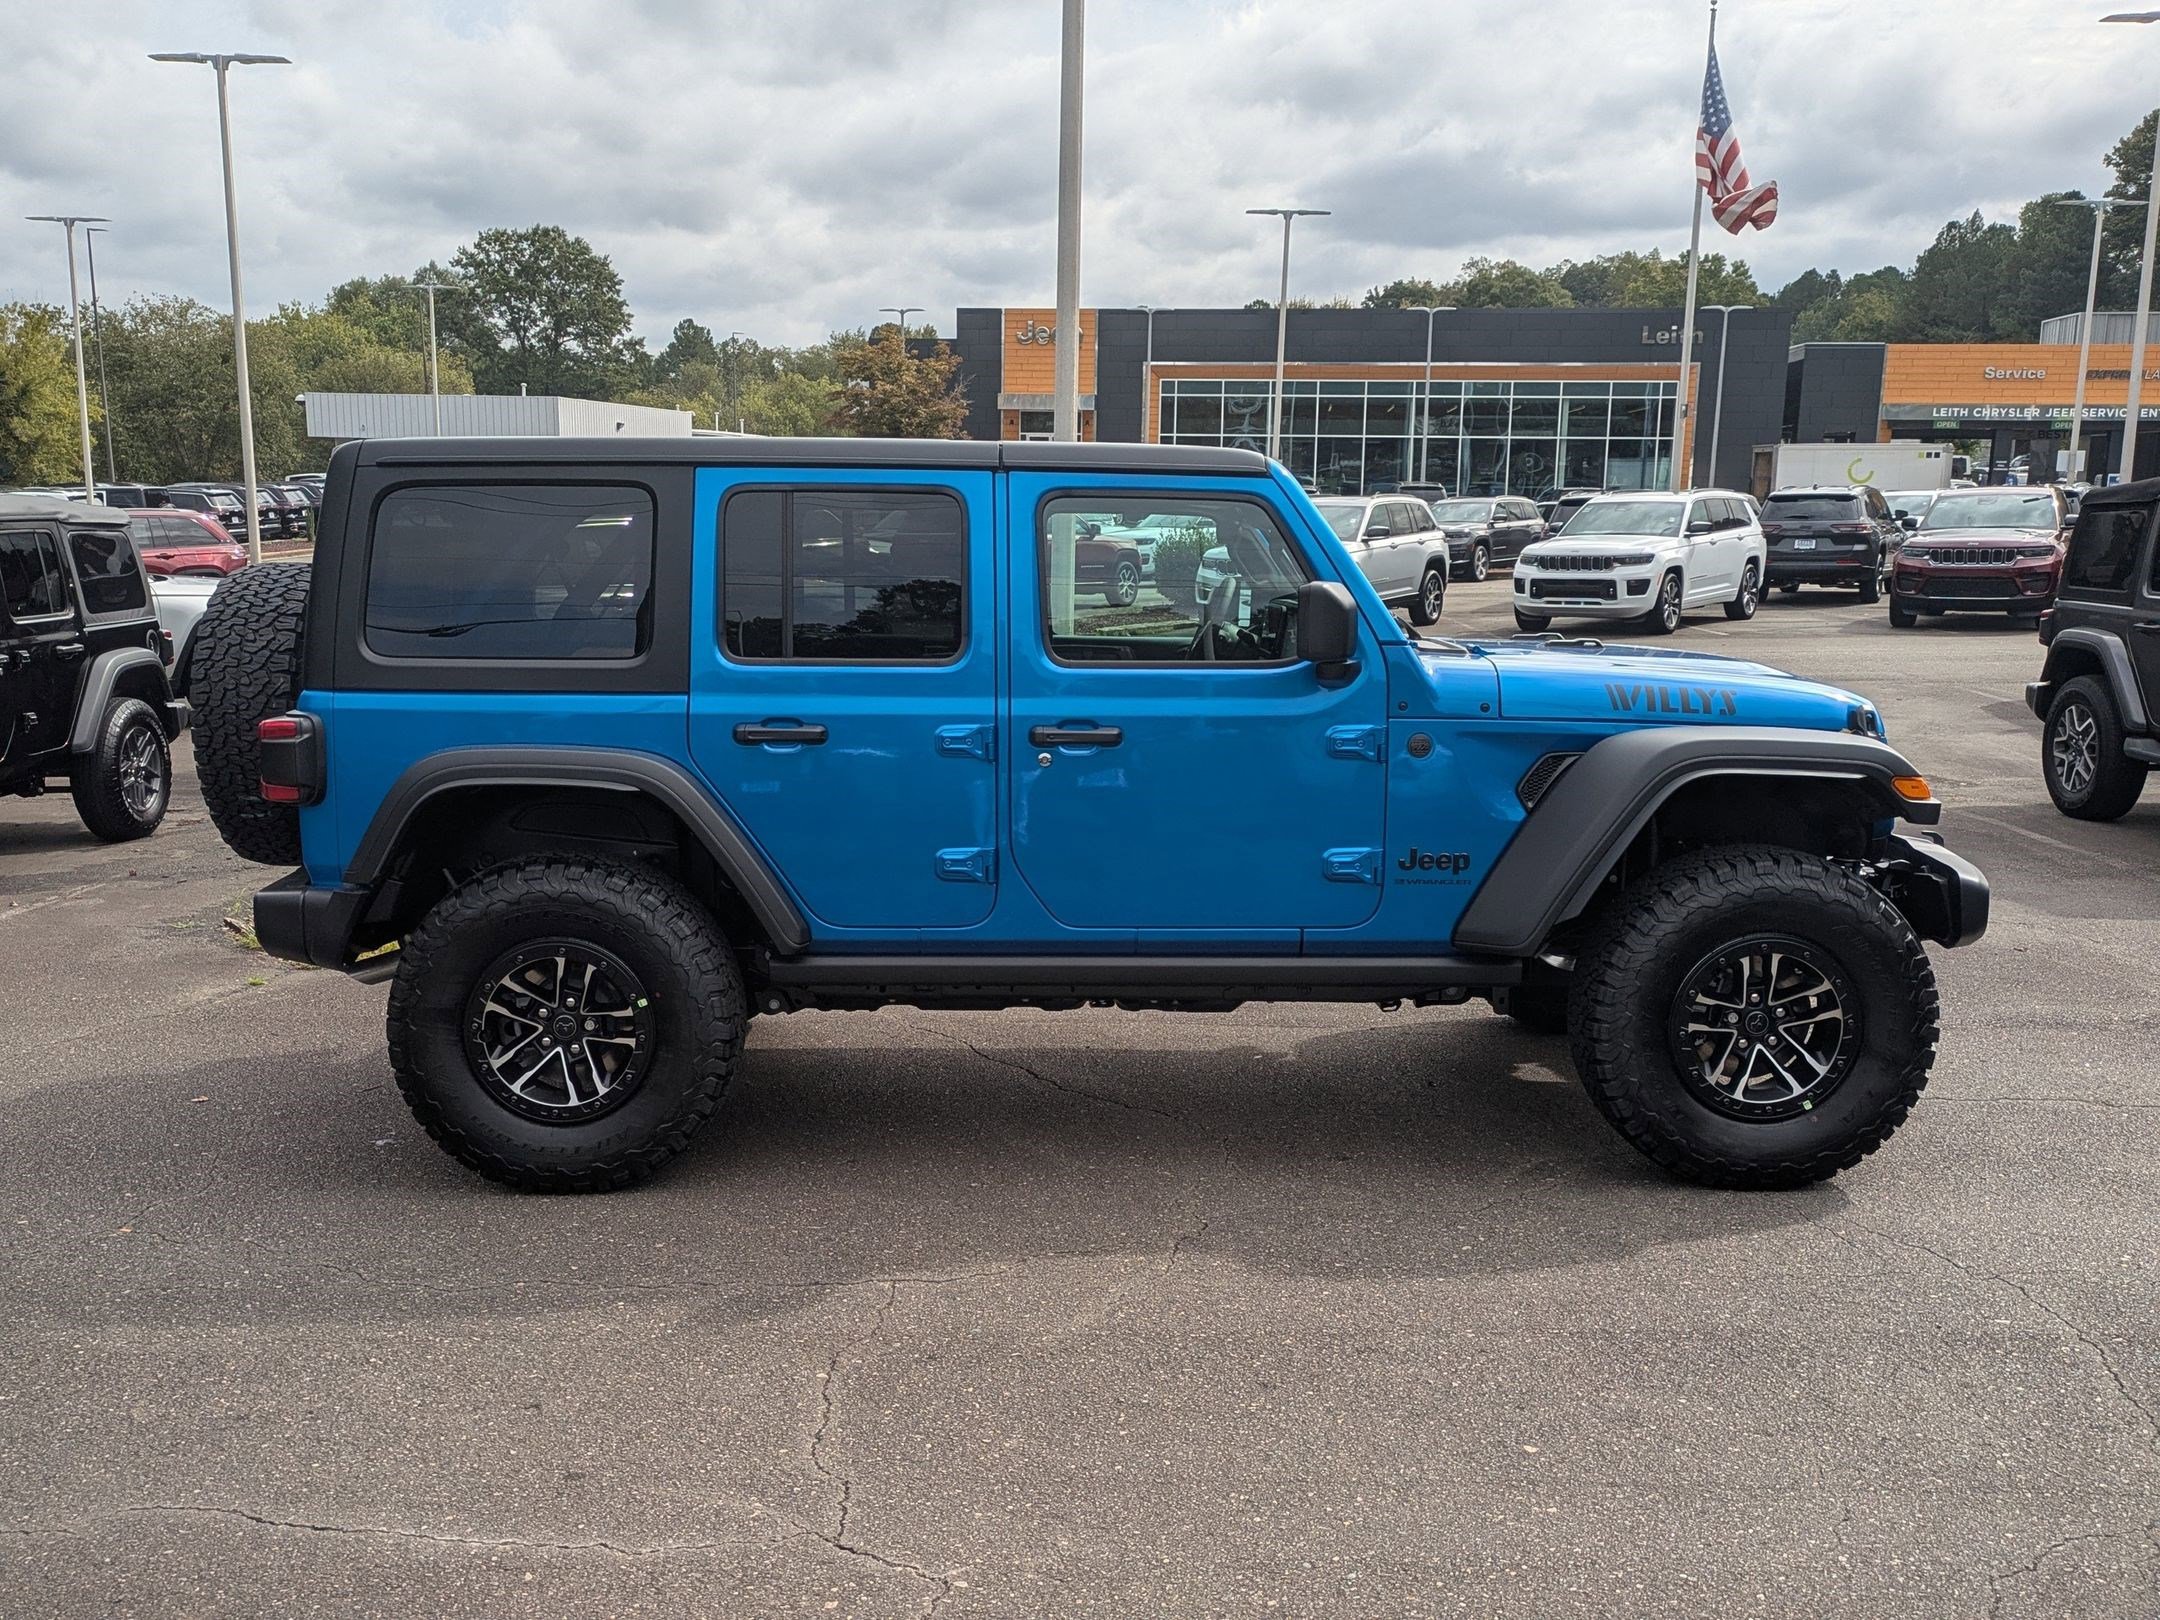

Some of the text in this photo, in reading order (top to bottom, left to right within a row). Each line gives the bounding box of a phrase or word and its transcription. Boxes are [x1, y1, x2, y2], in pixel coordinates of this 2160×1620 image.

[1016, 320, 1083, 346] Je
[1984, 366, 2046, 379] Service
[1932, 407, 1968, 417] LEITH
[1973, 407, 2040, 417] CHRYSLER
[2081, 407, 2128, 418] SERVIC
[2038, 430, 2072, 439] BEST
[1604, 684, 1737, 716] WILLYS
[1398, 846, 1471, 875] Jeep
